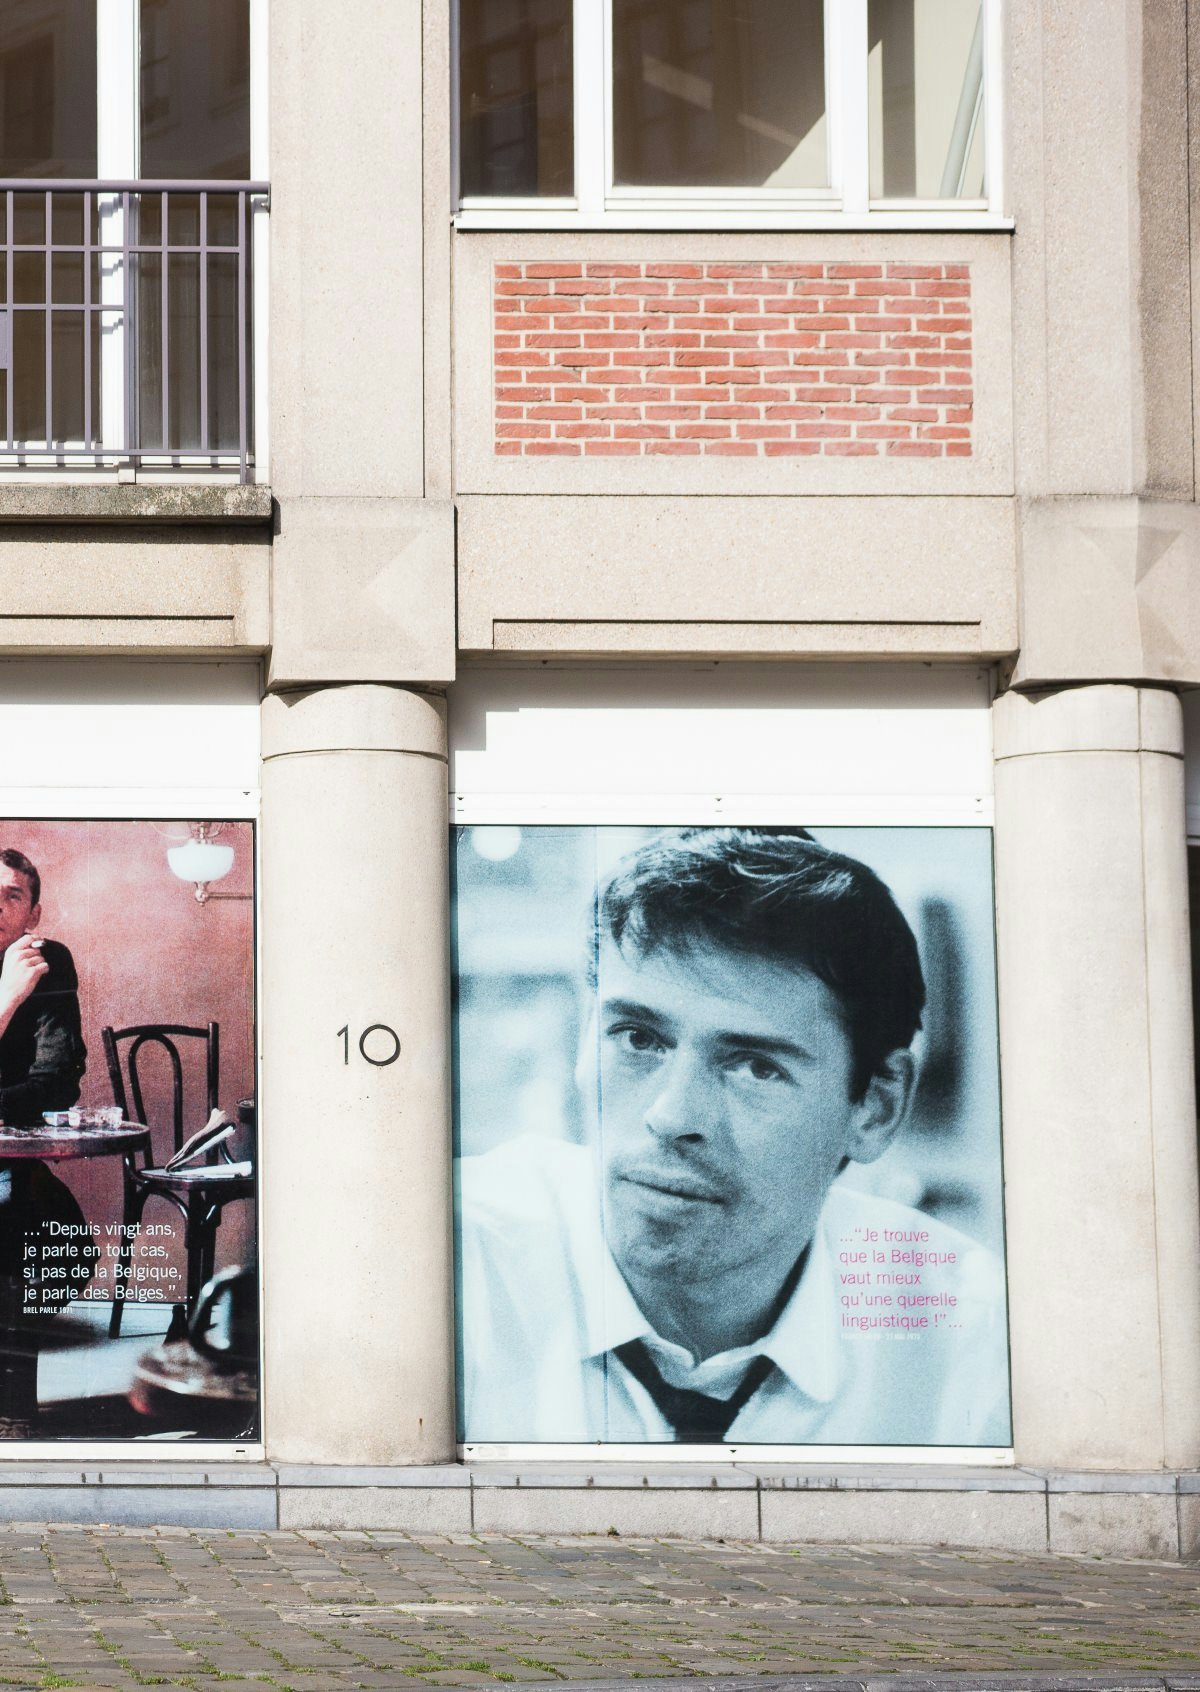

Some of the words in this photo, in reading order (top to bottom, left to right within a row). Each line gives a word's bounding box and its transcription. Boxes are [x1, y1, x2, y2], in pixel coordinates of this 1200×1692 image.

[336, 1024, 402, 1067] 10
[105, 1221, 142, 1239] vingt
[145, 1224, 176, 1239] ans,
[883, 1228, 929, 1242] trouve
[23, 1242, 37, 1261] je
[42, 1242, 79, 1261] parle
[82, 1245, 101, 1257] en
[105, 1243, 136, 1257] tout
[140, 1245, 169, 1260] cas,
[839, 1251, 868, 1267] que
[872, 1249, 885, 1264] la
[891, 1249, 957, 1267] Belgique
[23, 1264, 35, 1279] si
[41, 1267, 67, 1282] pas
[70, 1264, 90, 1279] de
[94, 1264, 107, 1278] la
[113, 1263, 182, 1282] Belgique,
[840, 1271, 872, 1285] vaut
[876, 1270, 922, 1285] mieux
[23, 1285, 37, 1303] je
[42, 1285, 79, 1303] parle
[83, 1285, 110, 1300] des
[840, 1291, 893, 1309] qu’une
[897, 1292, 958, 1309] querelle
[23, 1306, 39, 1314] BREL
[39, 1306, 58, 1314] PARLE
[841, 1312, 929, 1331] linguistique
